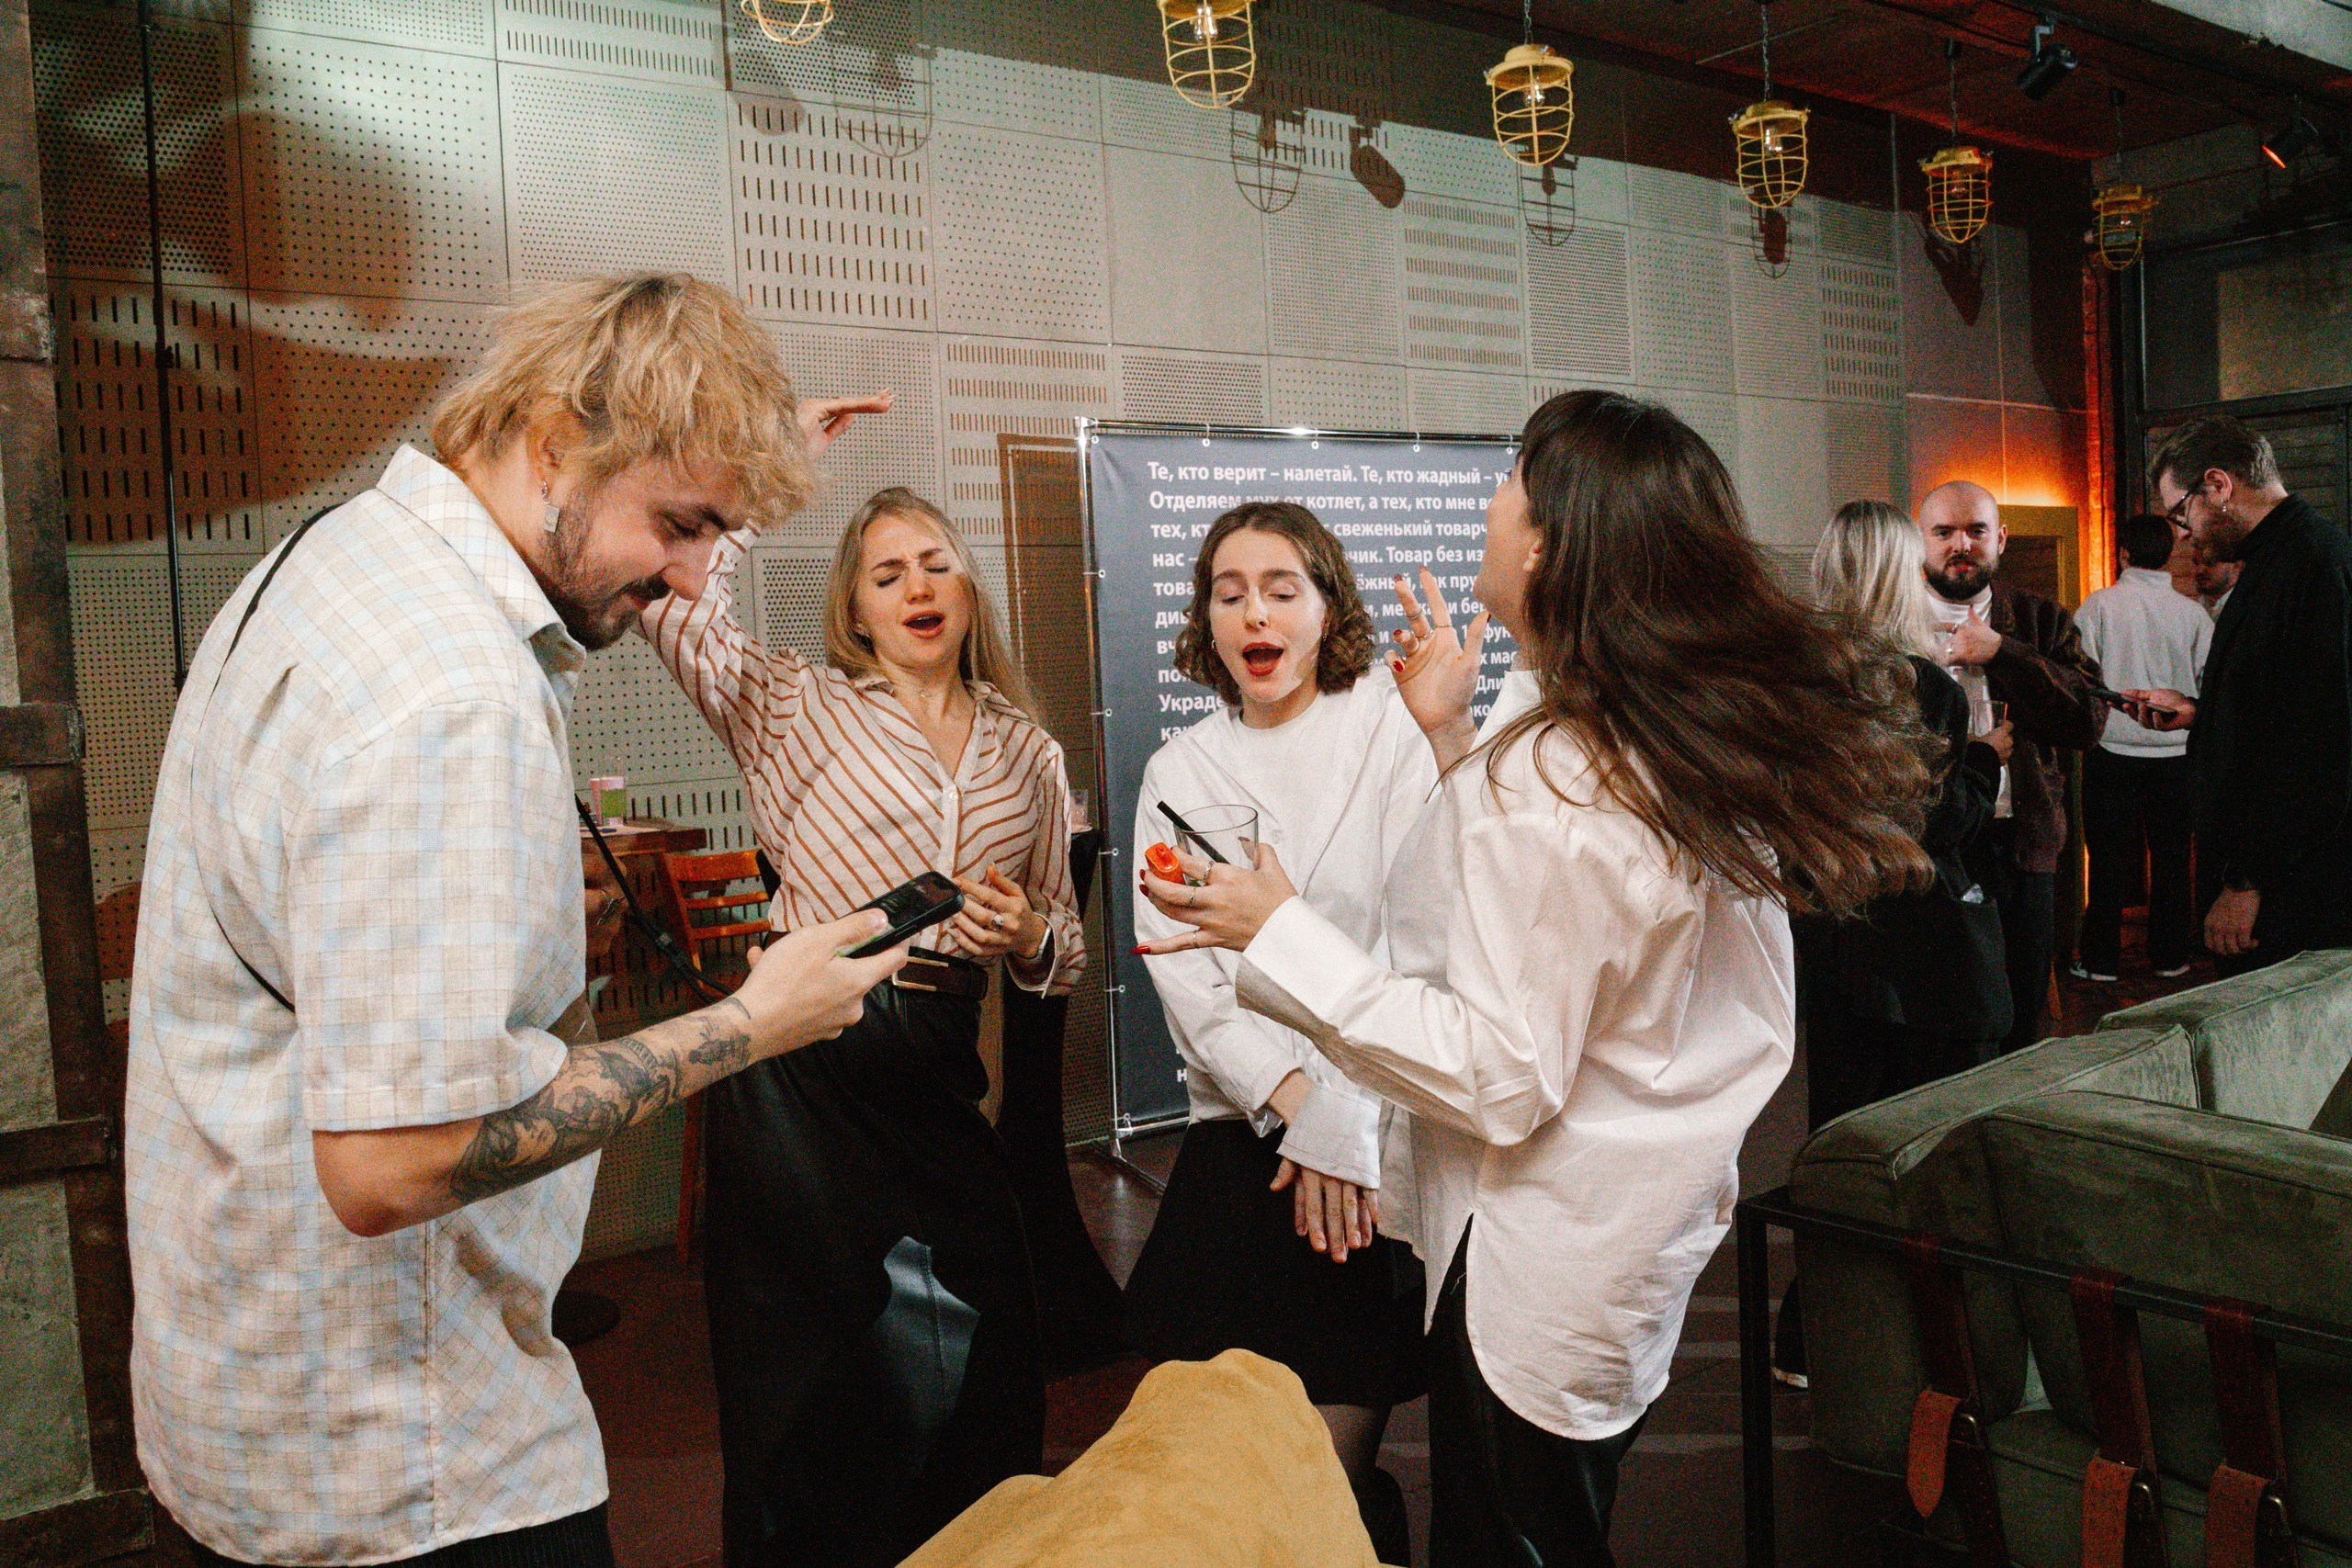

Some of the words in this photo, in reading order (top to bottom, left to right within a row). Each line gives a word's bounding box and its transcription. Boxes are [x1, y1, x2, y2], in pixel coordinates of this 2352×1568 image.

[1148, 461, 1174, 482] Те,
[1178, 467, 1209, 480] кто
[1213, 467, 1267, 485] верит
[1283, 465, 1358, 482] налетай.
[1360, 465, 1383, 484] Те,
[1386, 469, 1413, 483] кто
[1417, 468, 1481, 487] жадный
[1149, 491, 1241, 513] Отделяем
[1306, 495, 1365, 512] котлет,
[1369, 497, 1378, 510] а
[1381, 497, 1412, 512] тех,
[1416, 497, 1442, 510] кто
[1445, 497, 1476, 511] мне
[1150, 524, 1187, 541] тех,
[1191, 524, 1211, 537] кт
[1333, 520, 1432, 536] свеженький
[1436, 523, 1487, 540] товарч
[1152, 553, 1185, 568] нас
[1345, 550, 1383, 563] чик.
[1385, 546, 1433, 567] Товар
[1436, 545, 1464, 563] без
[1466, 549, 1485, 562] из
[1153, 581, 1196, 596] това
[1450, 575, 1477, 592] пру
[1484, 623, 1511, 643] фун
[1159, 694, 1225, 716] Украде
[1475, 674, 1504, 695] Дли
